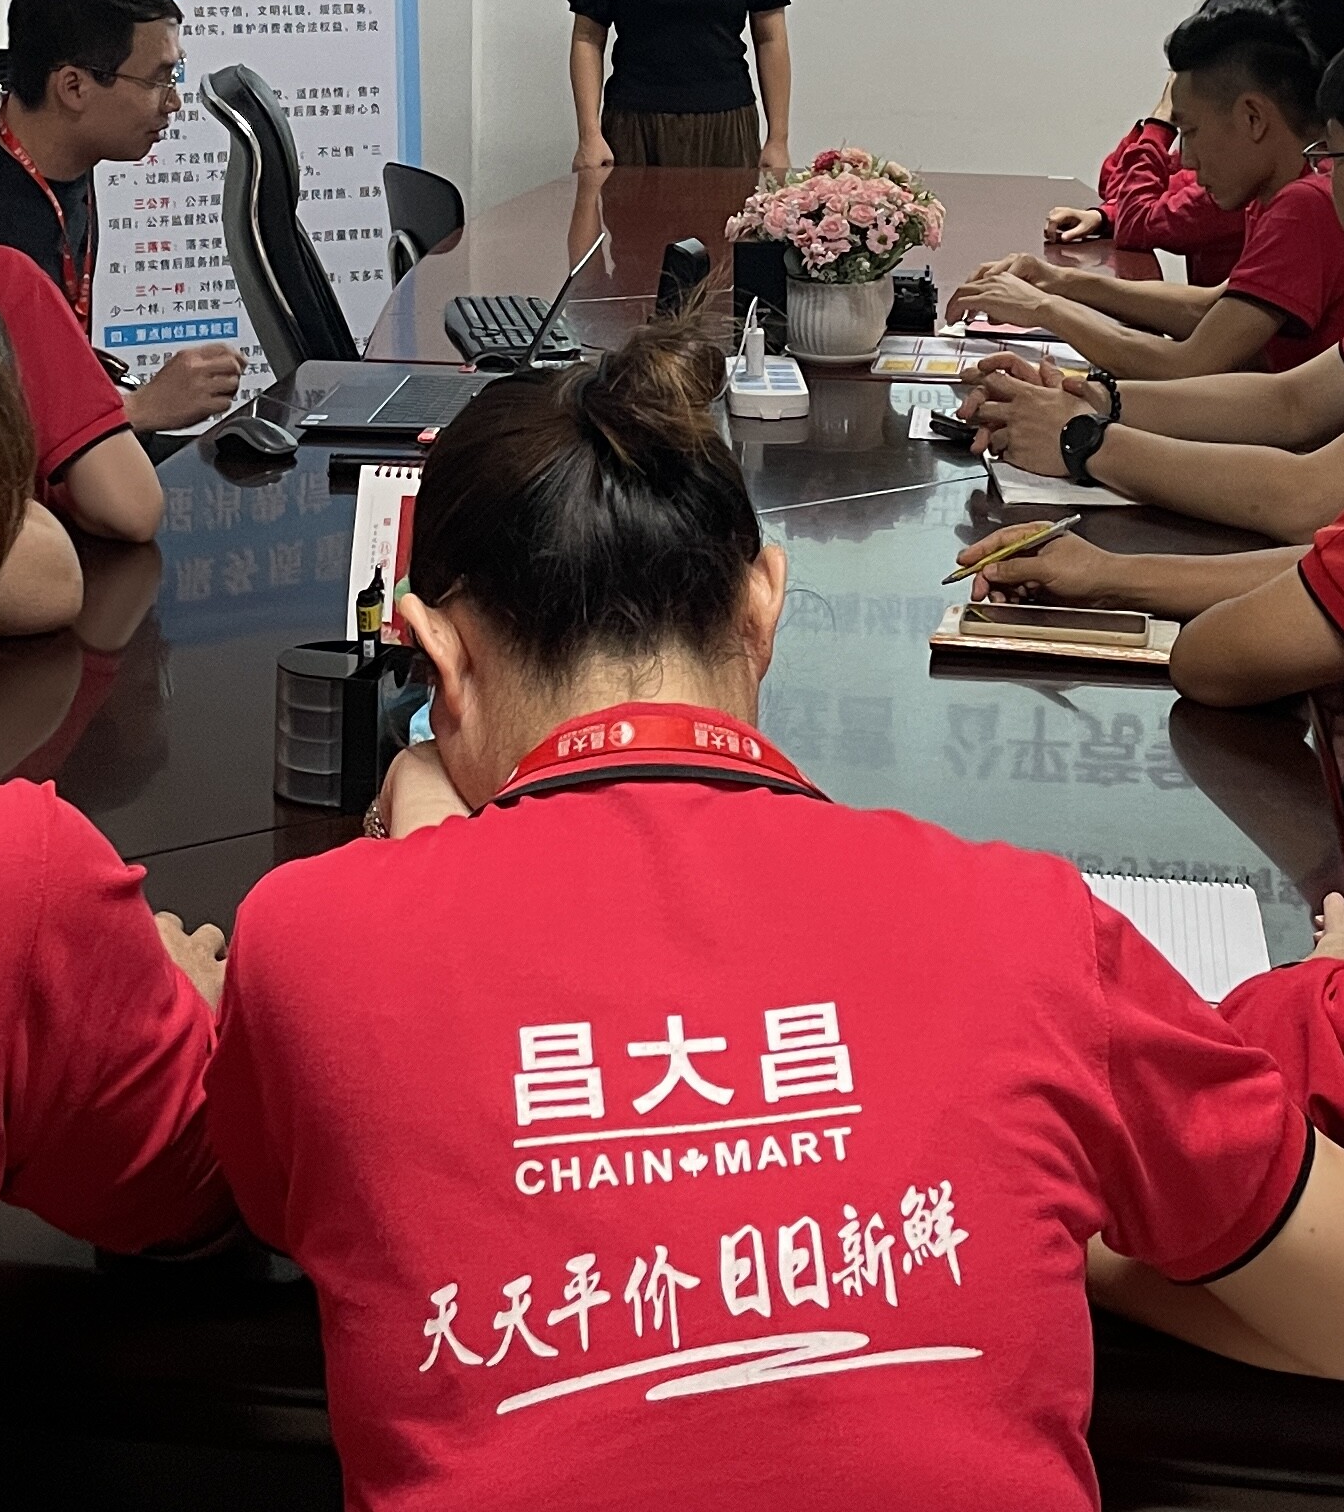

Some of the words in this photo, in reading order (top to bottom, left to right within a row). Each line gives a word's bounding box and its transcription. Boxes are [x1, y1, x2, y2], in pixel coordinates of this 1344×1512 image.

[512, 1001, 855, 1127] 昌大昌
[515, 1148, 674, 1196] CHAIN
[715, 1126, 854, 1178] MART
[419, 1243, 701, 1373] 天天平价
